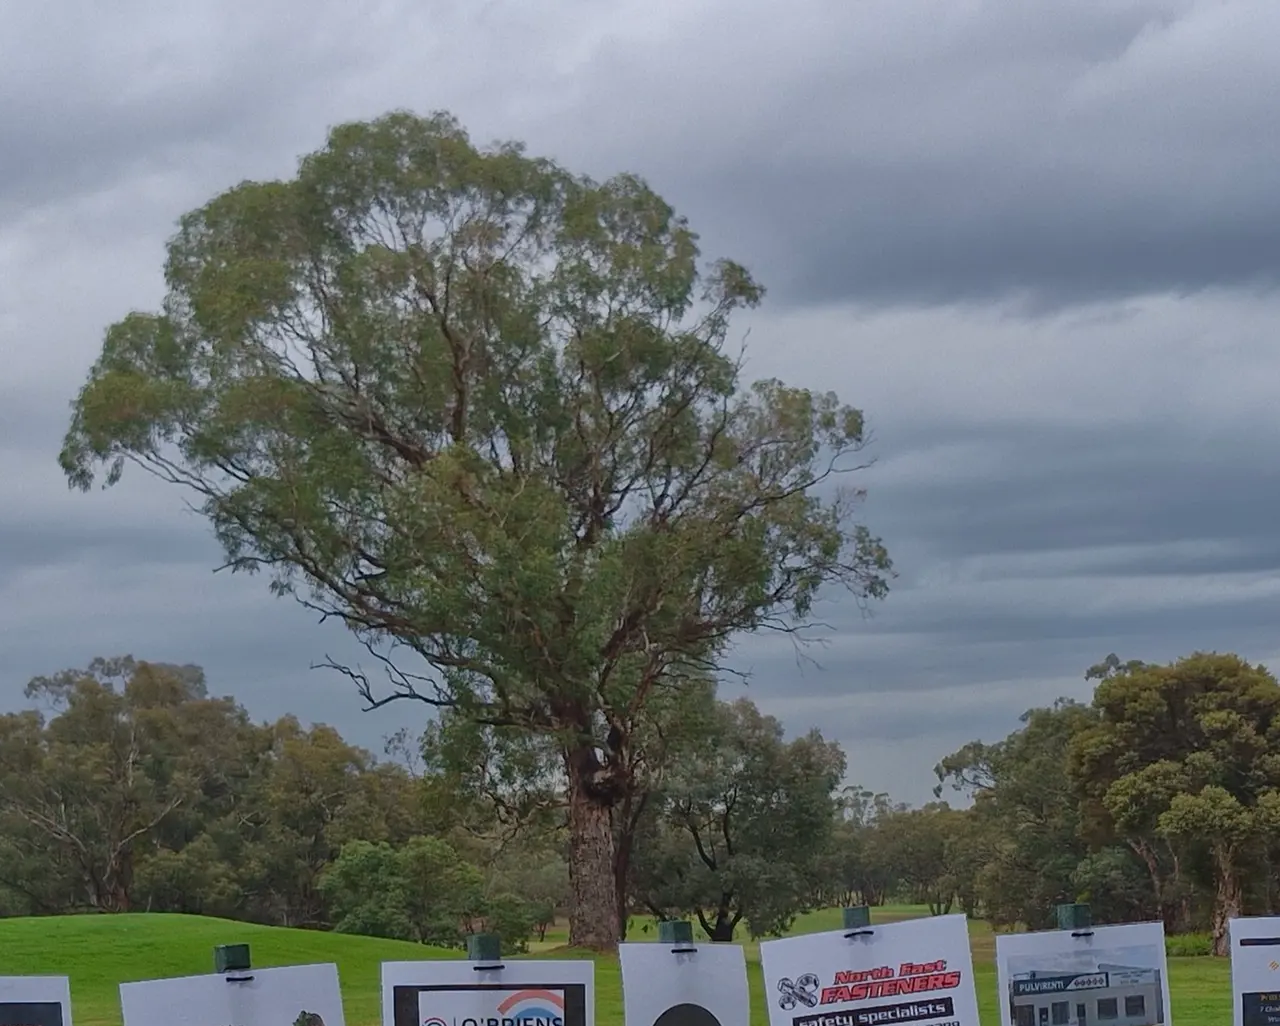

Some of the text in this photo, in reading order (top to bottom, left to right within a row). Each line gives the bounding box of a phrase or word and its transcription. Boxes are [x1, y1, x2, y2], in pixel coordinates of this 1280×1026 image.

[834, 959, 947, 985] North East
[820, 971, 961, 1006] FASTENERS
[859, 1002, 946, 1024] specialists
